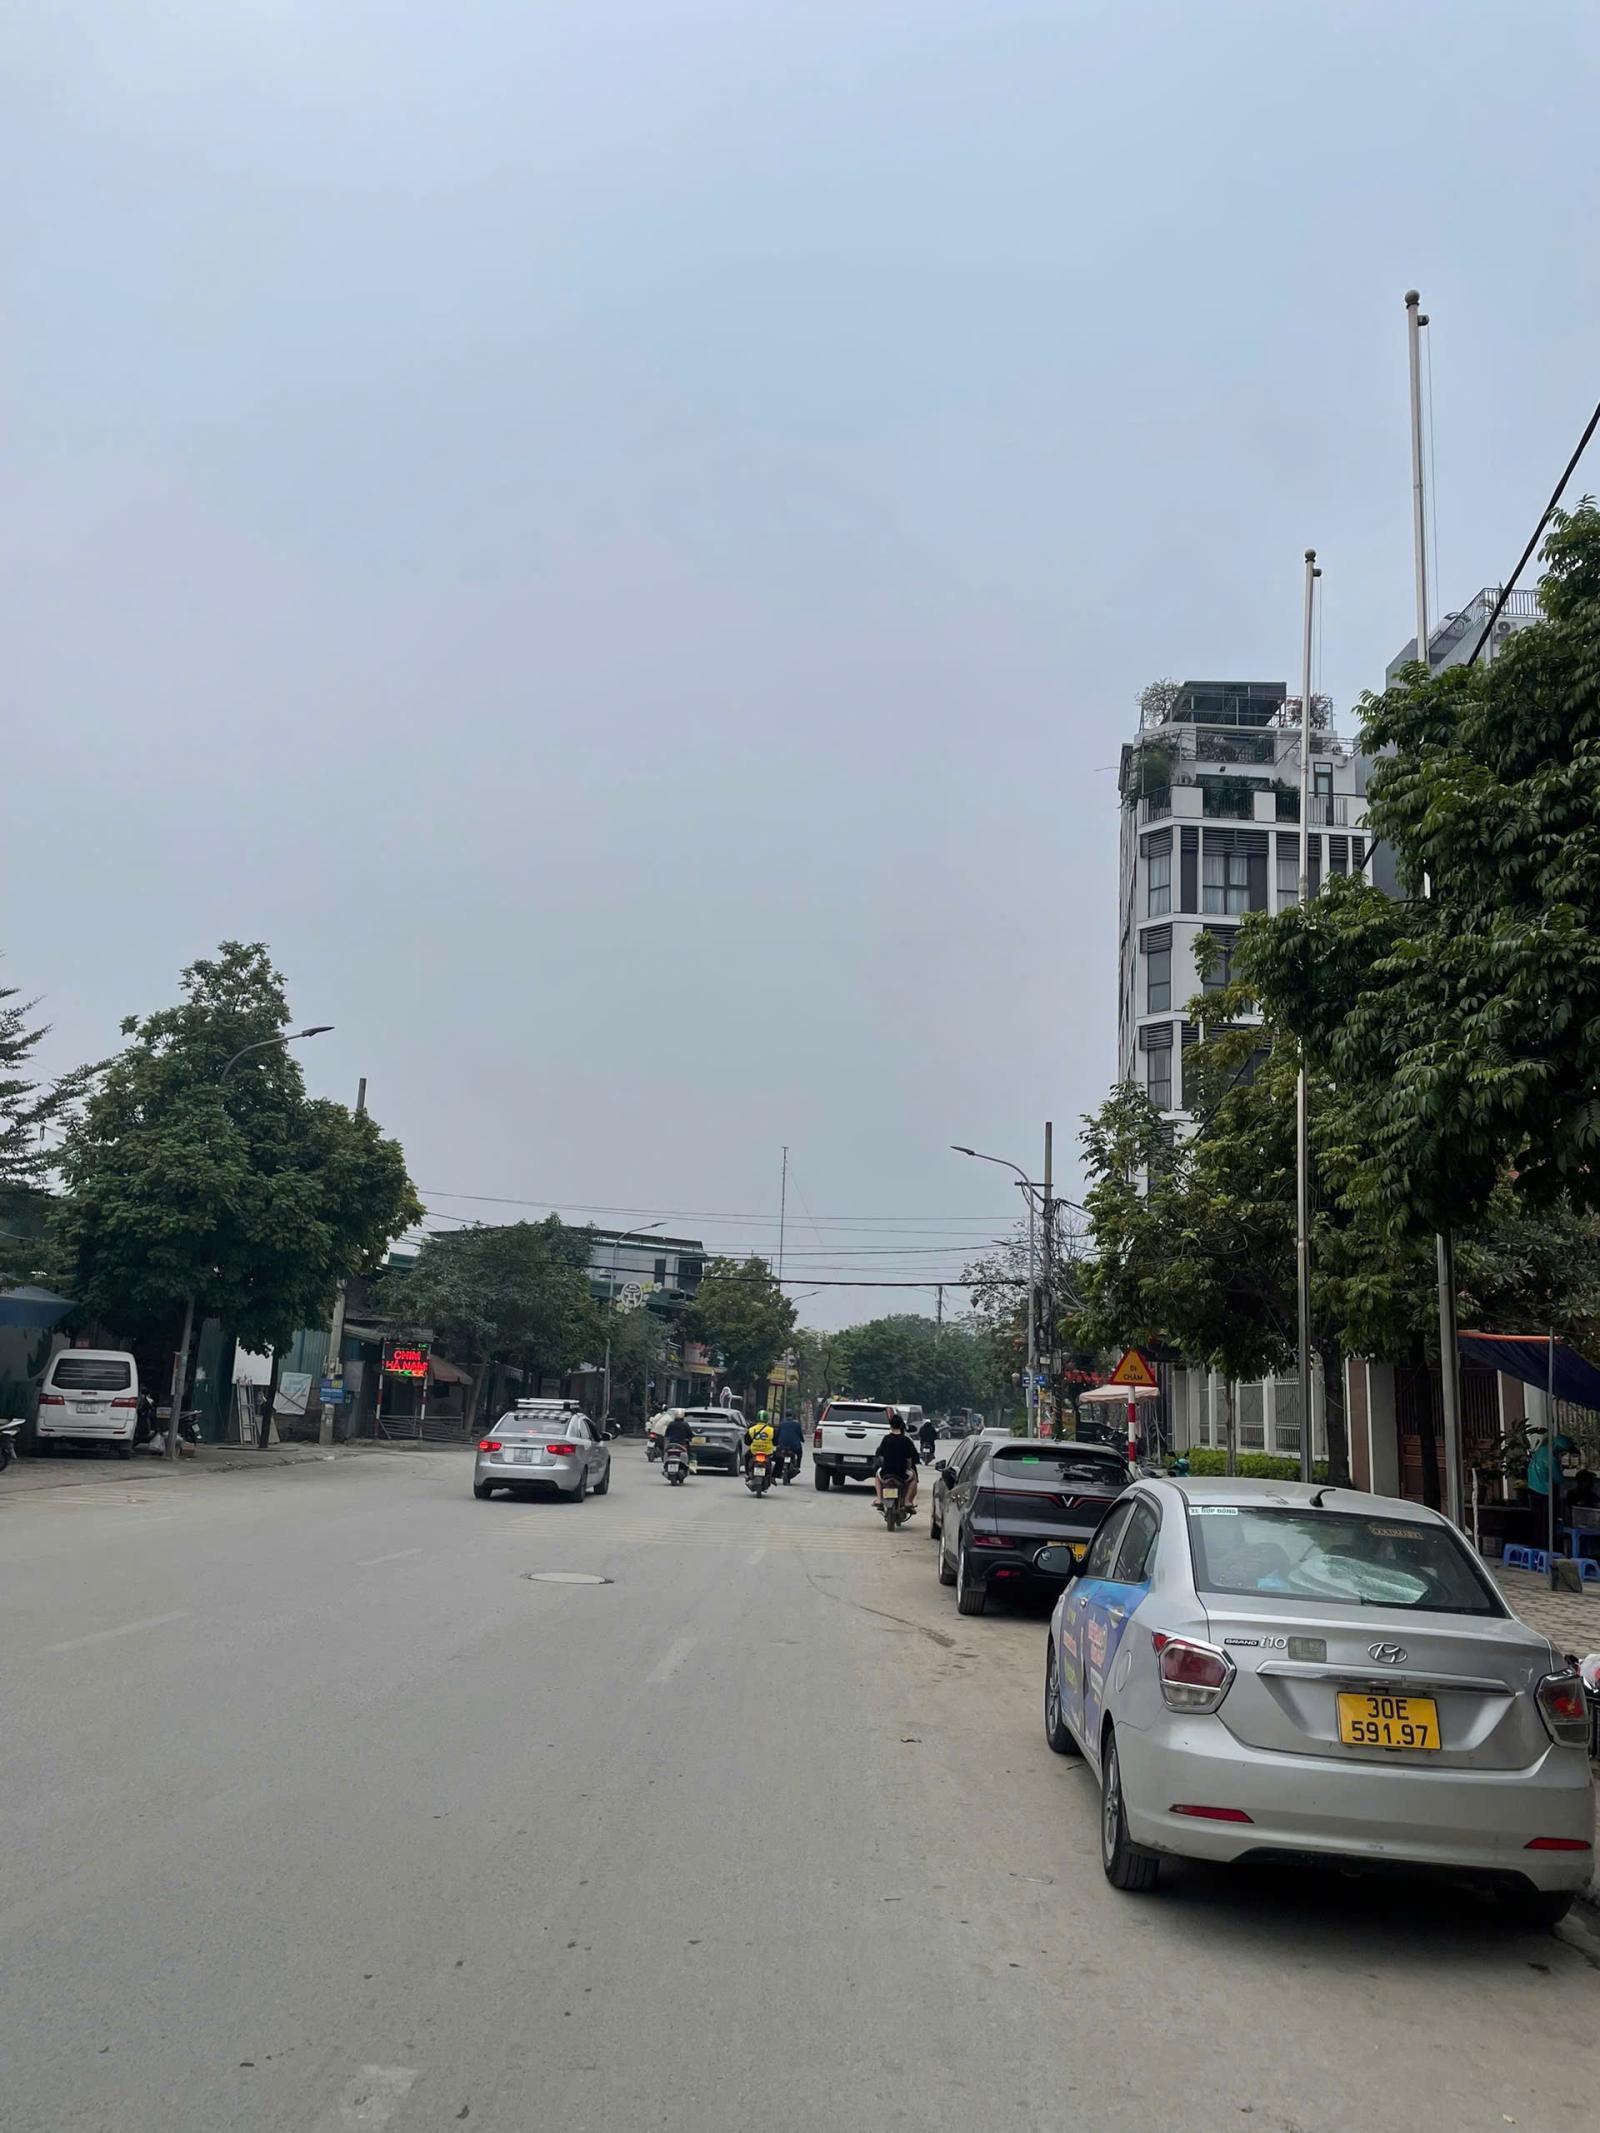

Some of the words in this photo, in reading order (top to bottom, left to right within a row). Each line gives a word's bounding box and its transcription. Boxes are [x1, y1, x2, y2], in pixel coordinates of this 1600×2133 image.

[1260, 1635, 1287, 1650] i10
[1366, 1697, 1409, 1720] 30E
[1351, 1720, 1428, 1747] 591.97
